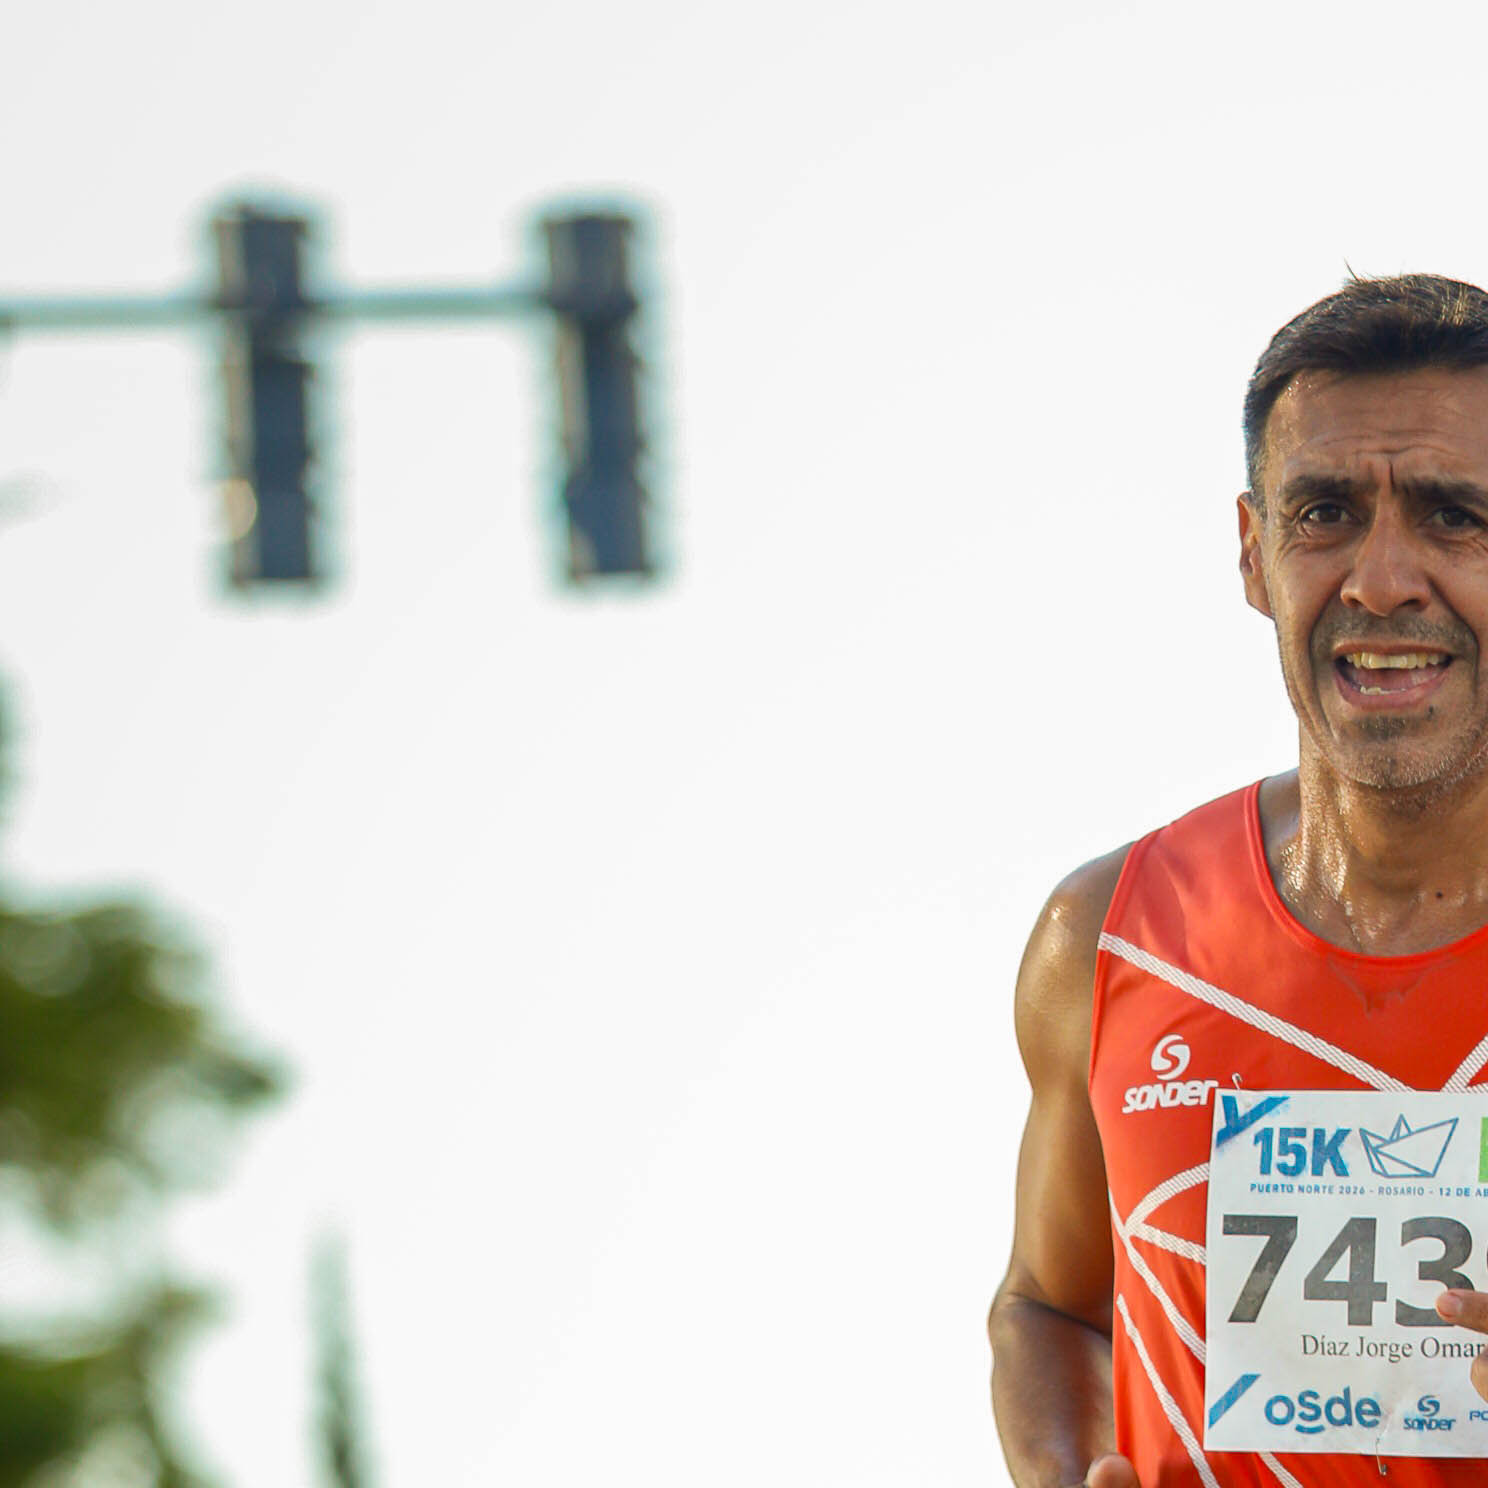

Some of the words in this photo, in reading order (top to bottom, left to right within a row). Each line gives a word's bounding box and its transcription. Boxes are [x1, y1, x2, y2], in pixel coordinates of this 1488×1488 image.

[1253, 1127, 1352, 1177] 15K
[1250, 1183, 1294, 1193] PUERTO
[1298, 1184, 1334, 1195] NORTE
[1339, 1185, 1365, 1195] 2026
[1378, 1186, 1425, 1196] ROSARIO
[1439, 1187, 1452, 1197] 12
[1456, 1187, 1471, 1197] DE
[1301, 1334, 1350, 1357] Díaz
[1356, 1336, 1413, 1363] Jorge
[1420, 1336, 1486, 1359] Omar
[1264, 1385, 1382, 1434] osde
